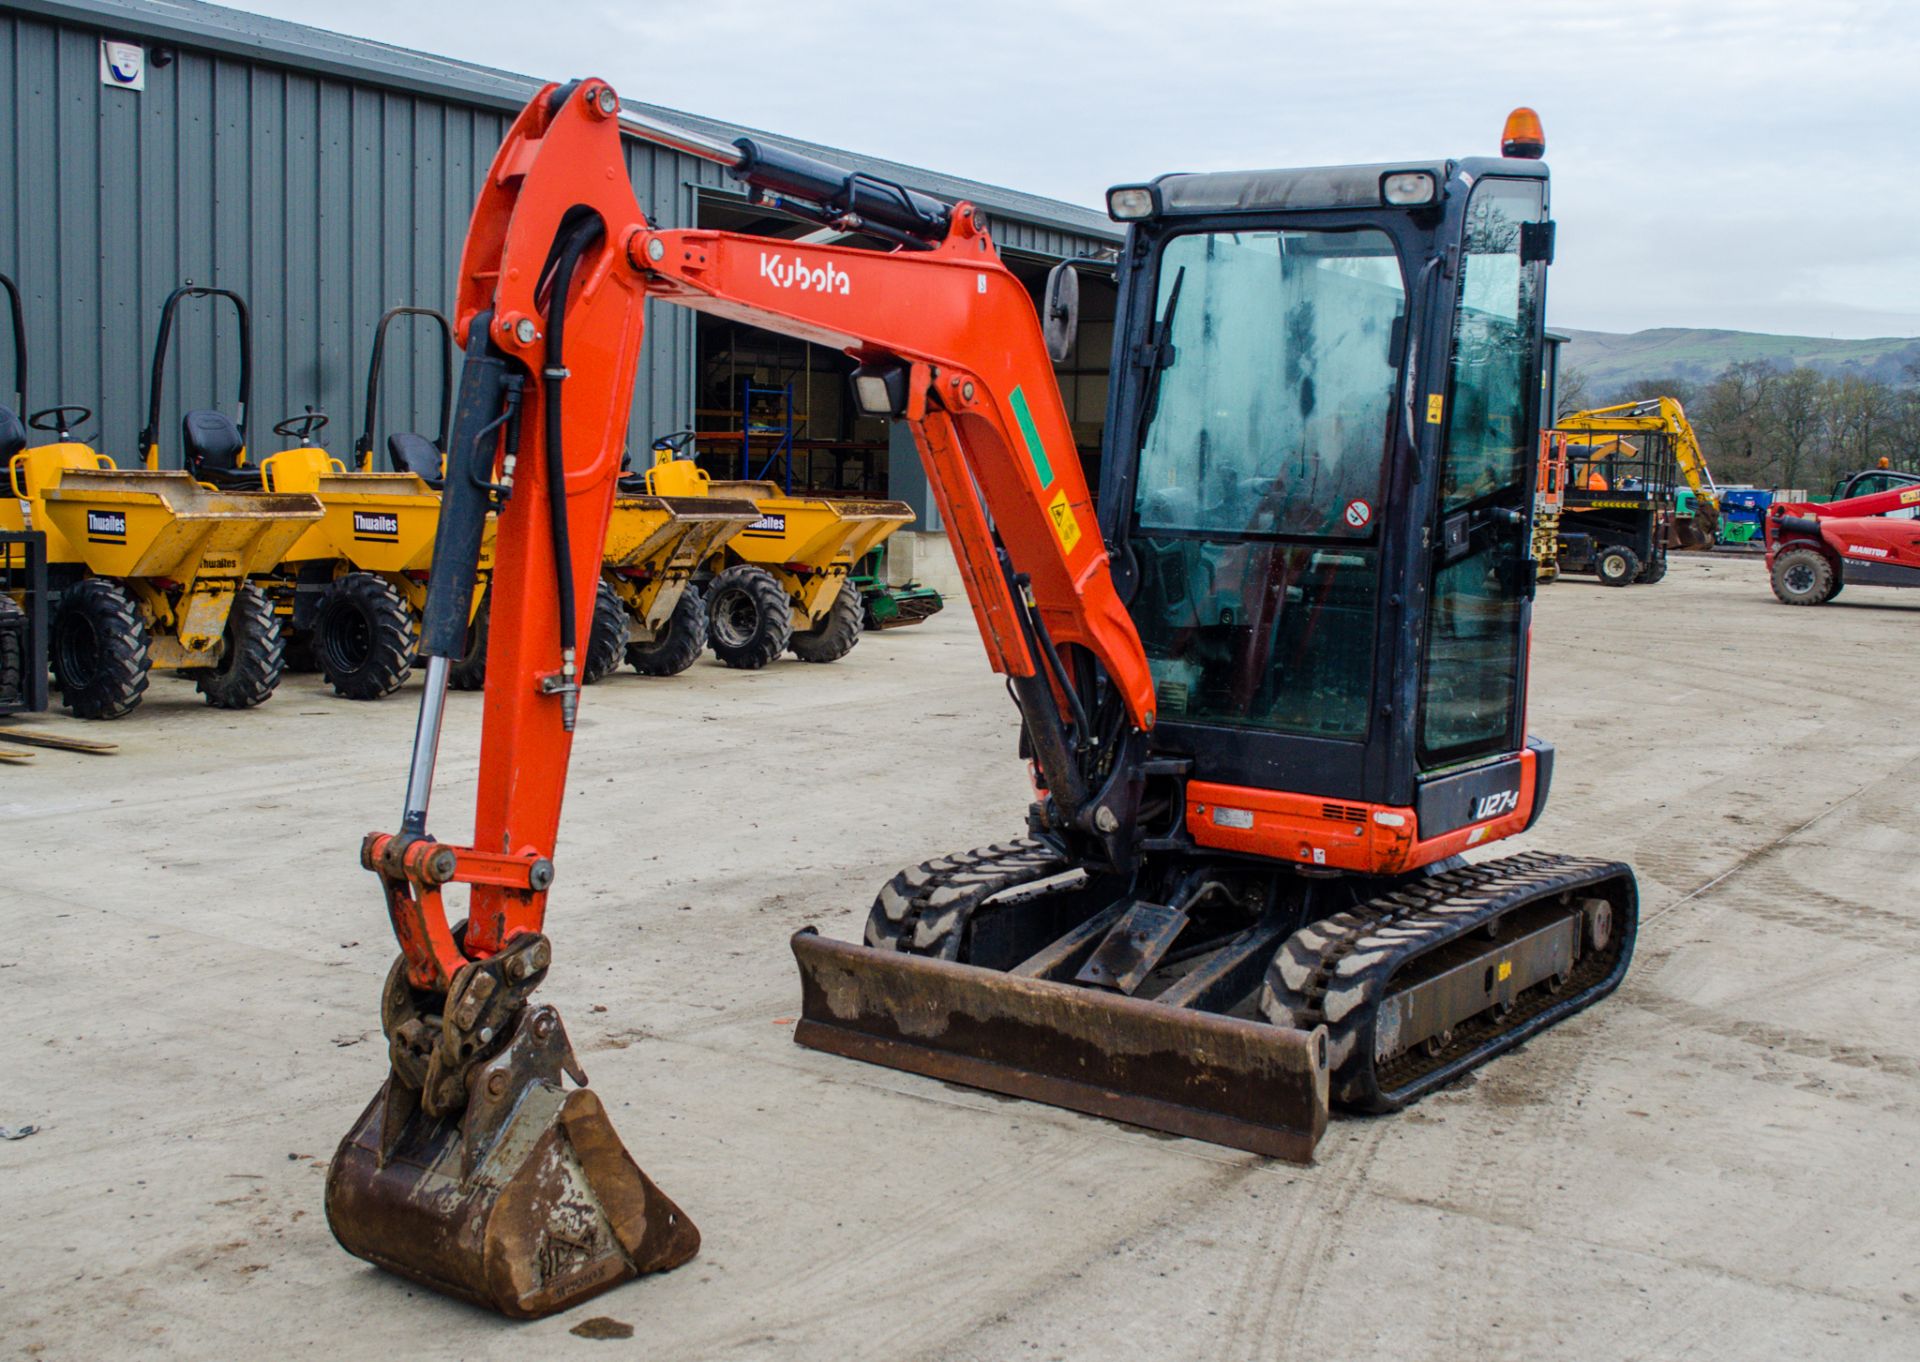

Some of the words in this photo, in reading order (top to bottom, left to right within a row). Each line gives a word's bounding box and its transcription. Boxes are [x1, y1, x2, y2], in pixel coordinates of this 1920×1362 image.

[760, 252, 850, 295] Kubota
[88, 513, 125, 532] Thwaites
[355, 514, 397, 532] Thwaites
[1848, 544, 1888, 558] MANITOU
[1476, 789, 1519, 819] U27-4
